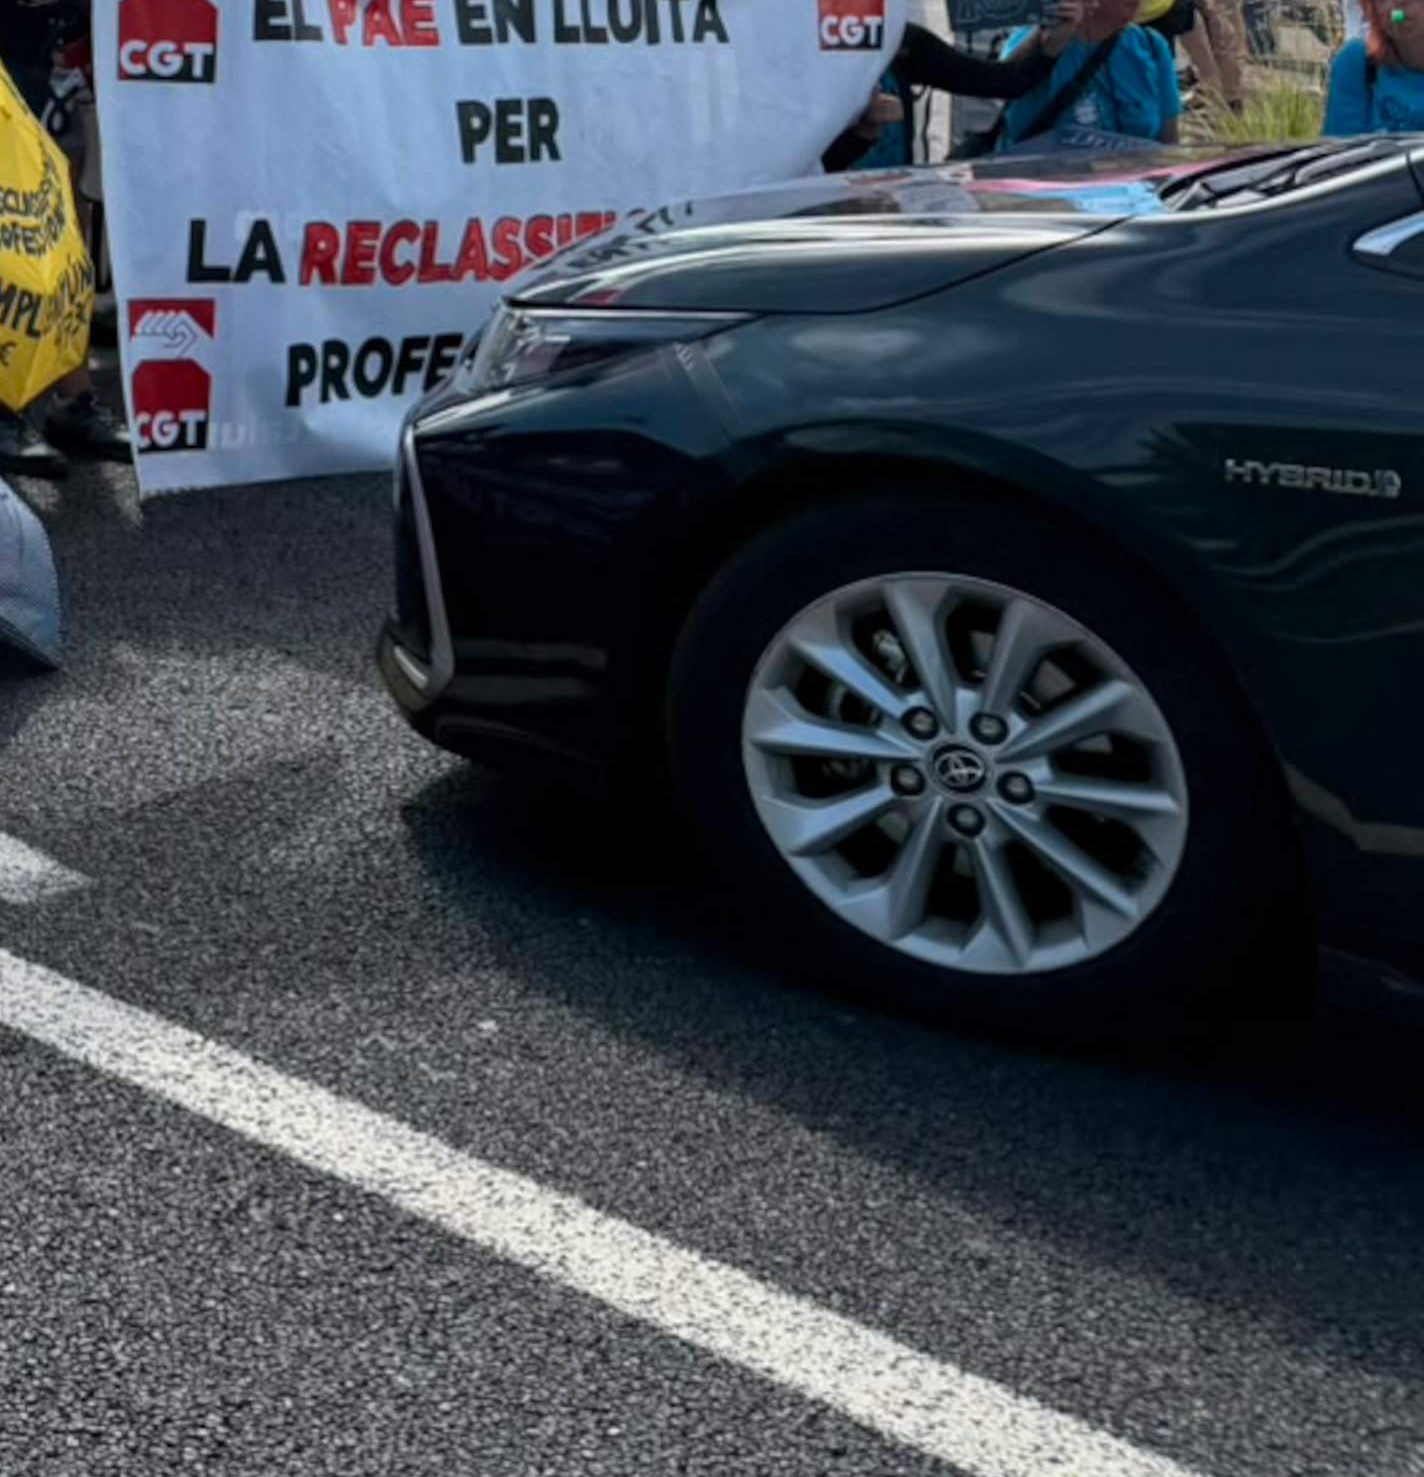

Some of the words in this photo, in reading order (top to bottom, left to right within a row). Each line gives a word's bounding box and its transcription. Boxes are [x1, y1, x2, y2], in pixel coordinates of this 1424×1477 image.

[819, 14, 884, 49] CGT
[117, 39, 216, 81] CGT
[456, 96, 563, 165] PER
[185, 217, 286, 286] LA
[135, 407, 209, 450] CGT
